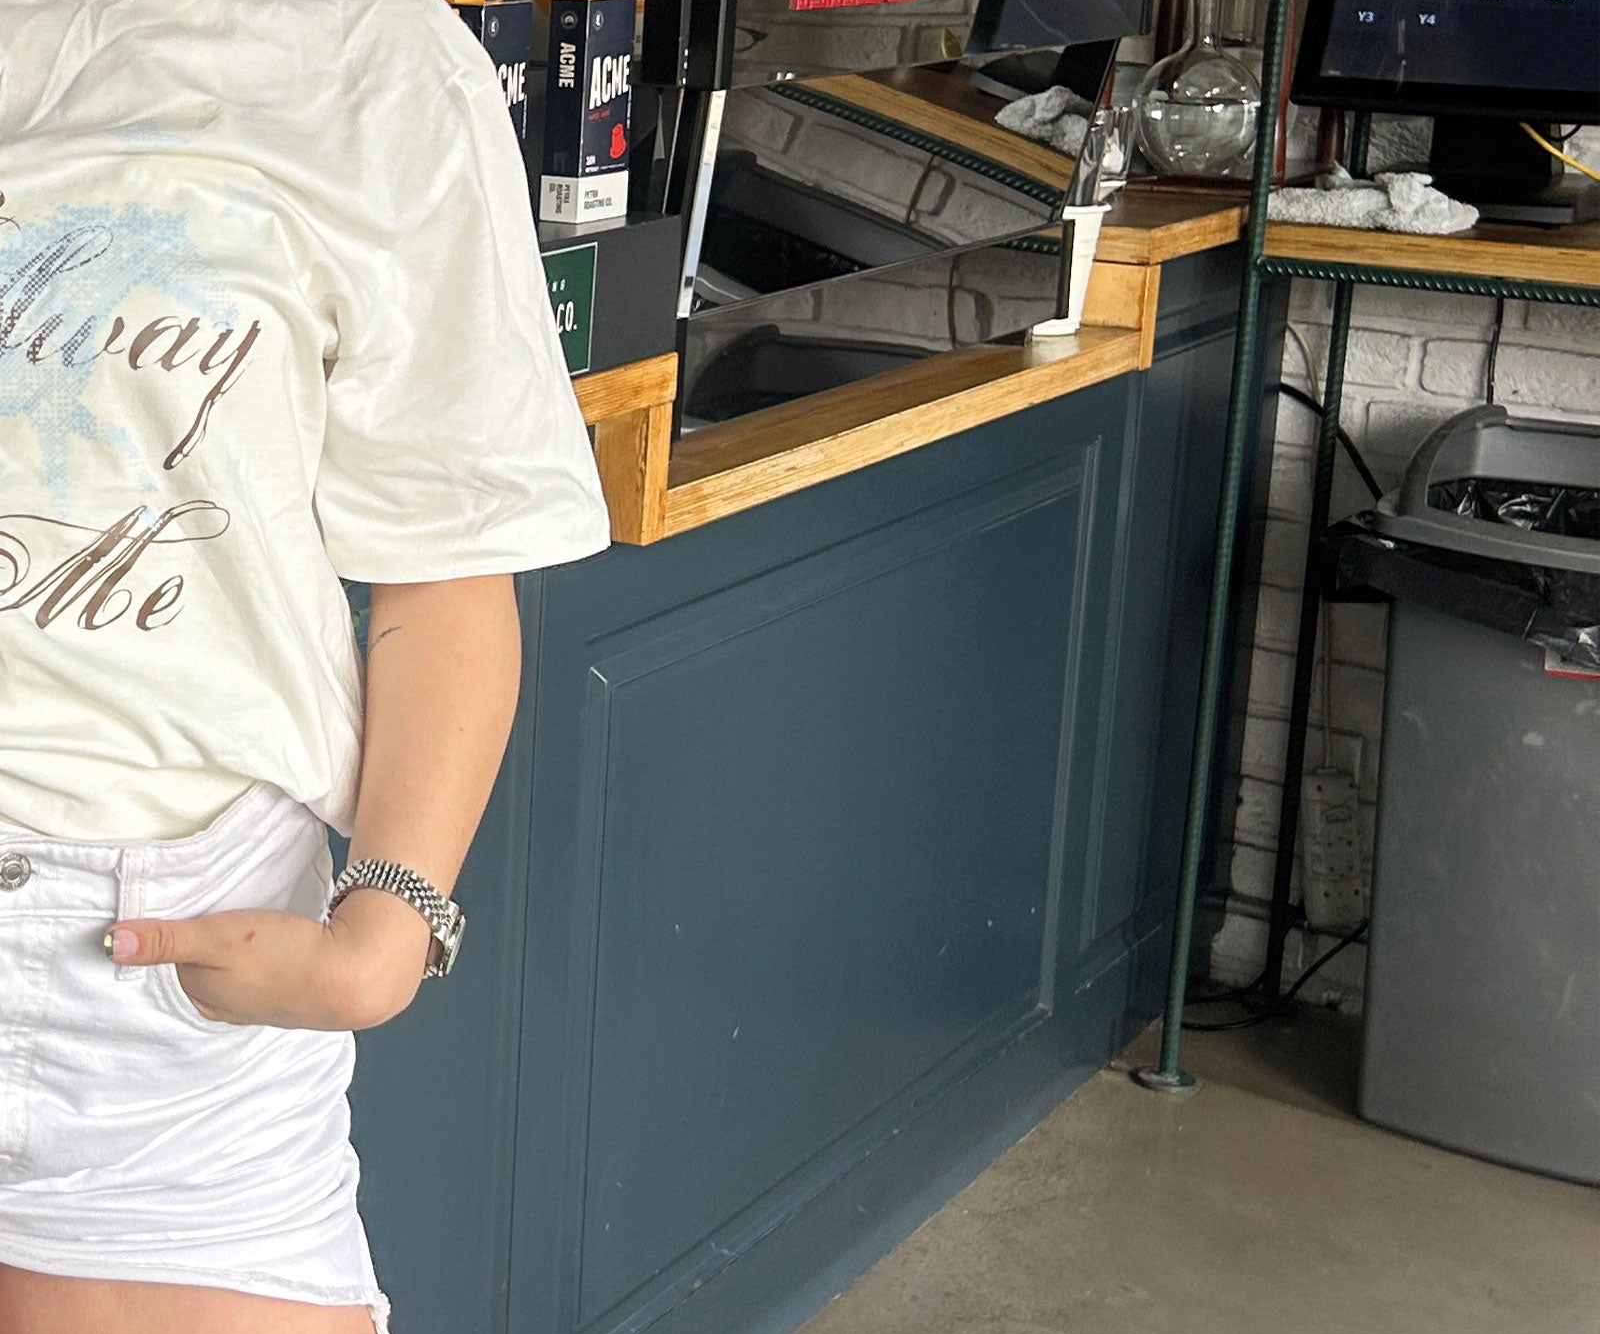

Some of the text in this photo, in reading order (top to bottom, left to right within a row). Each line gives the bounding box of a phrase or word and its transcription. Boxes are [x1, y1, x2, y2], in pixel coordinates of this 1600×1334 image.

[1358, 11, 1436, 25] Y3 Y4
[498, 62, 527, 107] CME
[559, 42, 576, 88] ACME
[589, 54, 631, 110] ACME
[556, 300, 578, 334] CO.
